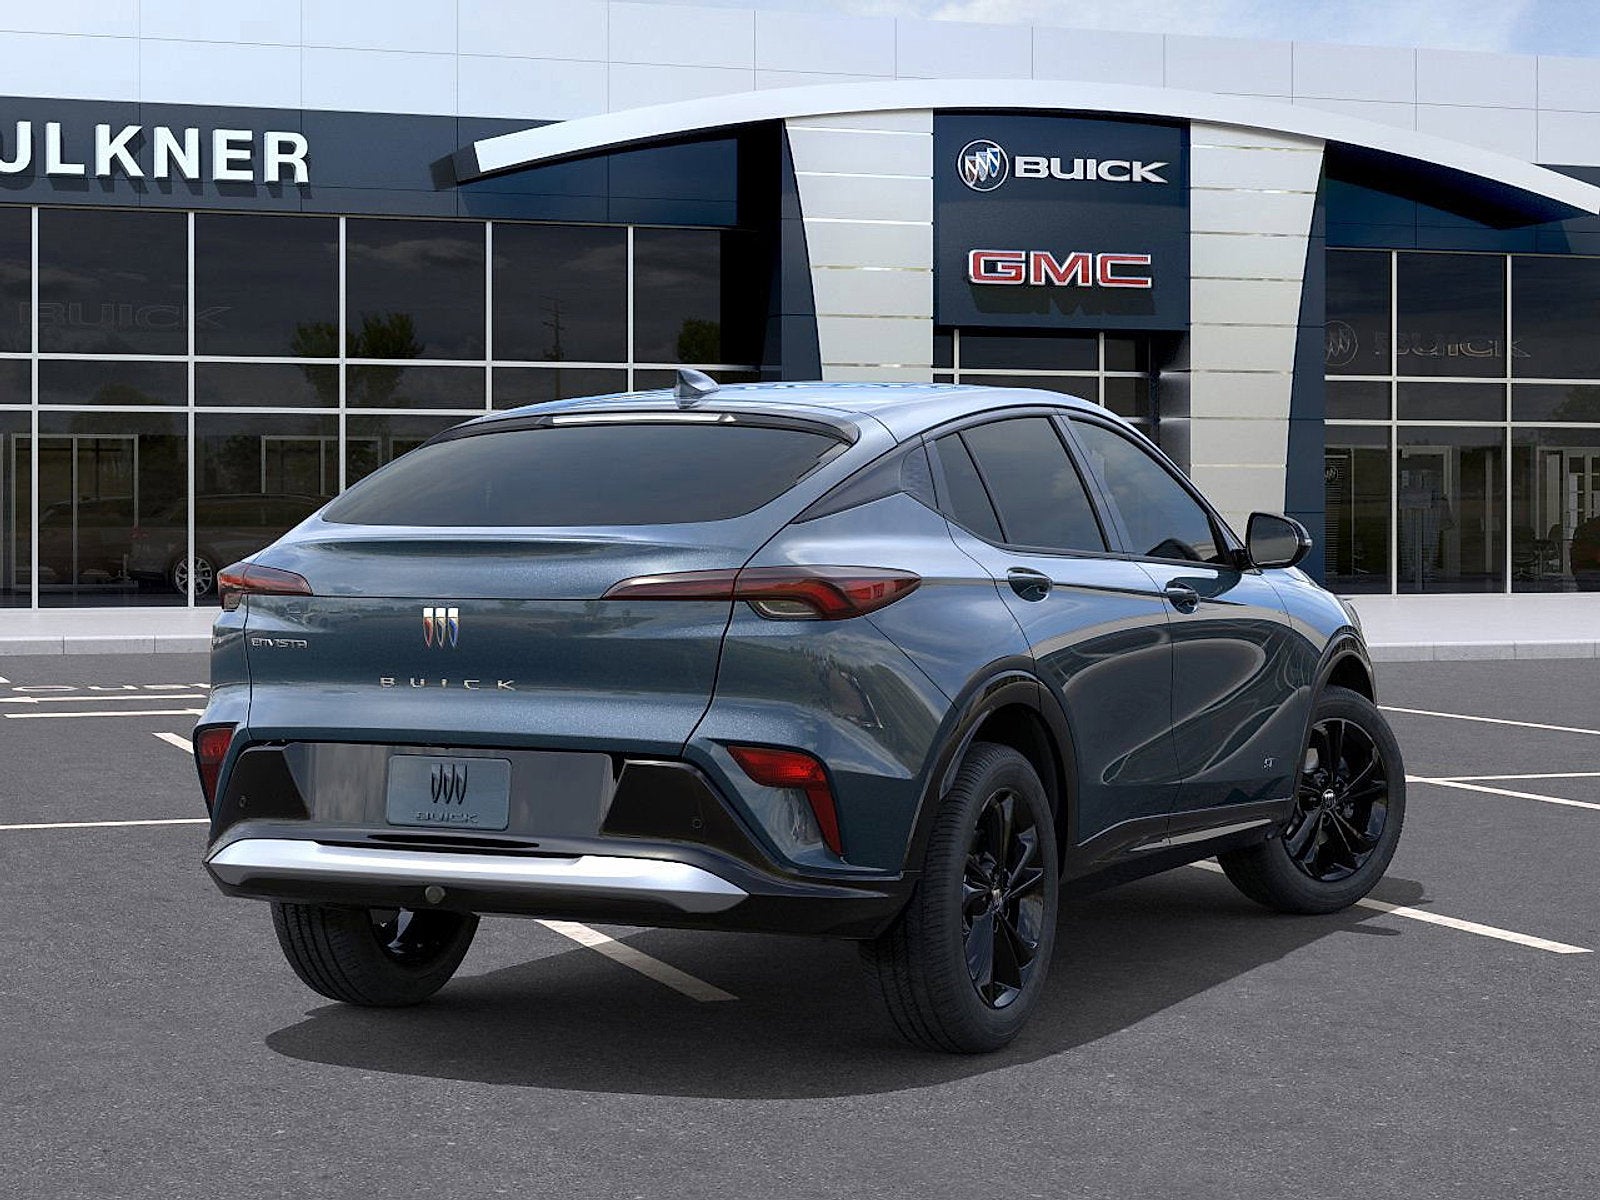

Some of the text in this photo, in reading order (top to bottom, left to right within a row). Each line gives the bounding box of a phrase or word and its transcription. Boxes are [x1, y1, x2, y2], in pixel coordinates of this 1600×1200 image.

[0, 121, 309, 183] ULKNER
[1014, 156, 1169, 184] BUICK
[968, 250, 1152, 288] GMC
[379, 677, 517, 691] BUICK
